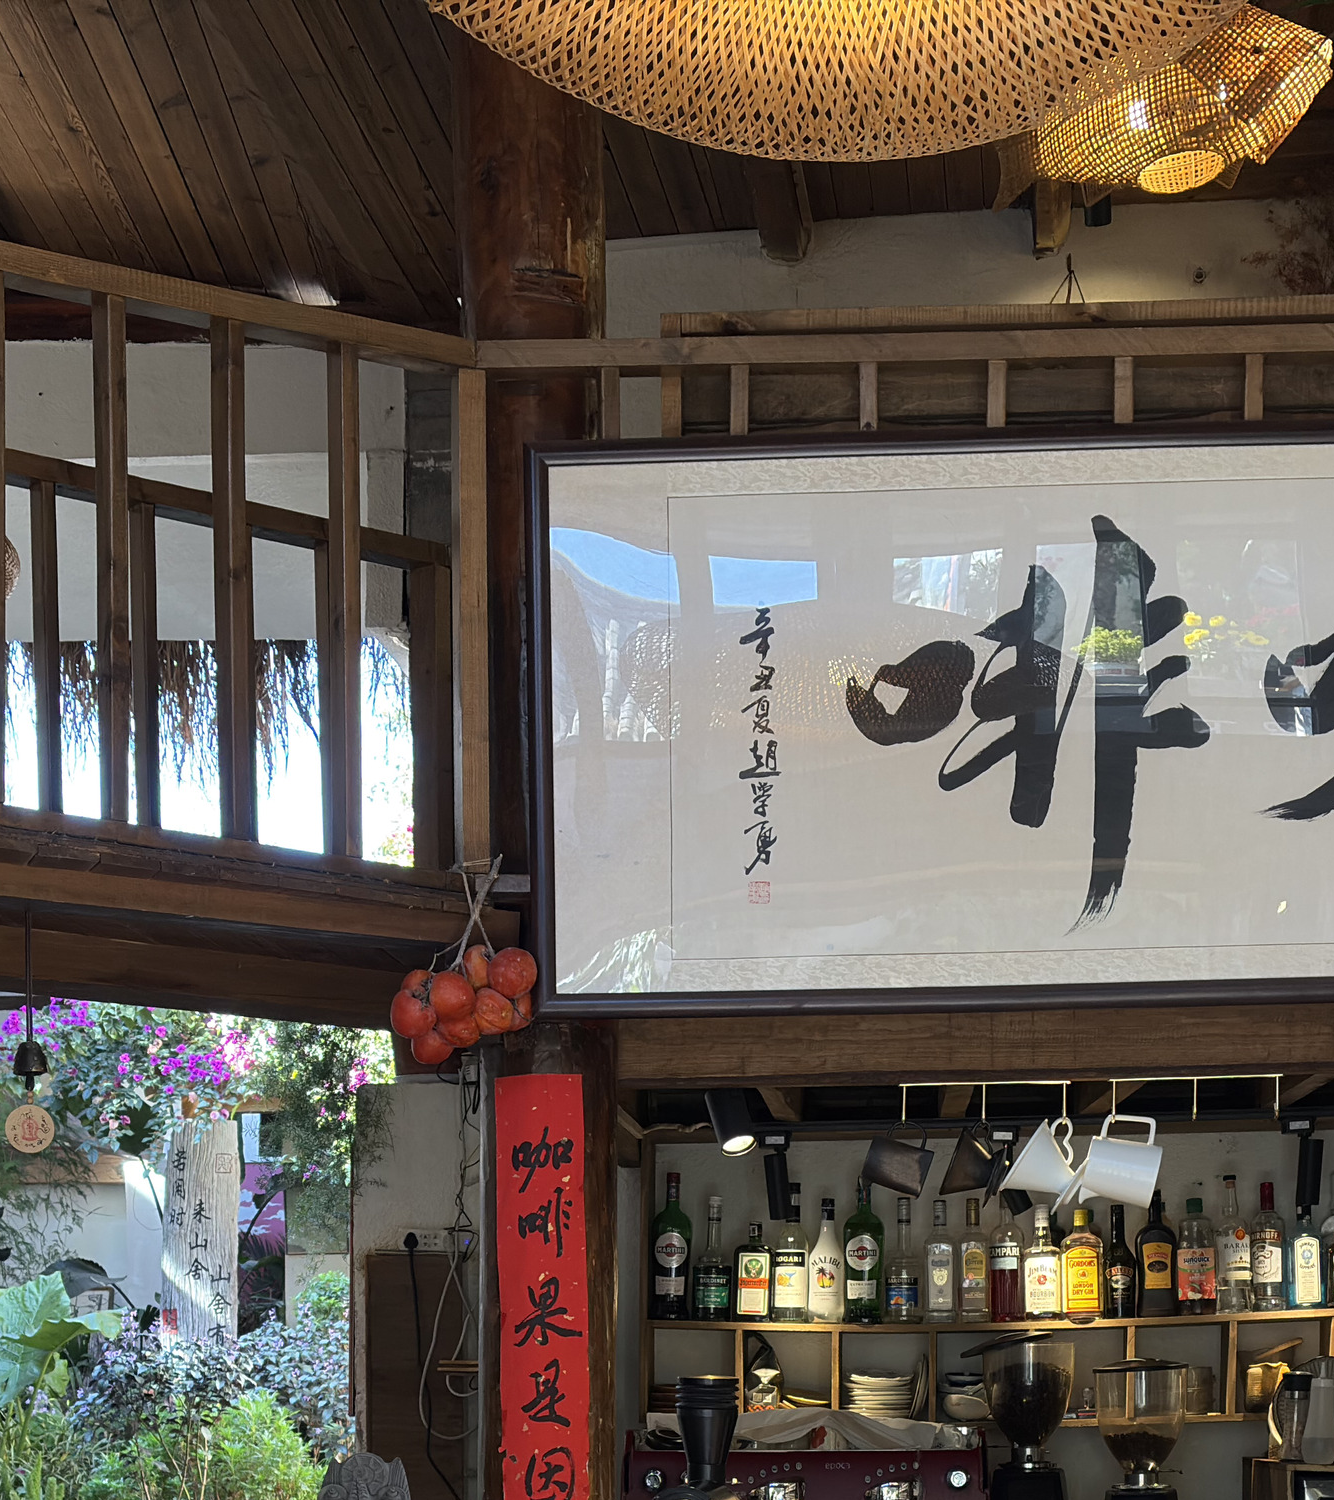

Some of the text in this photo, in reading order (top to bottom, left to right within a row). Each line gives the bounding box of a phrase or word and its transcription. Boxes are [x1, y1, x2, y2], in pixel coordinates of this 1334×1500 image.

[184, 1199, 212, 1281] 来山舍
[811, 1254, 843, 1270] MALIBU
